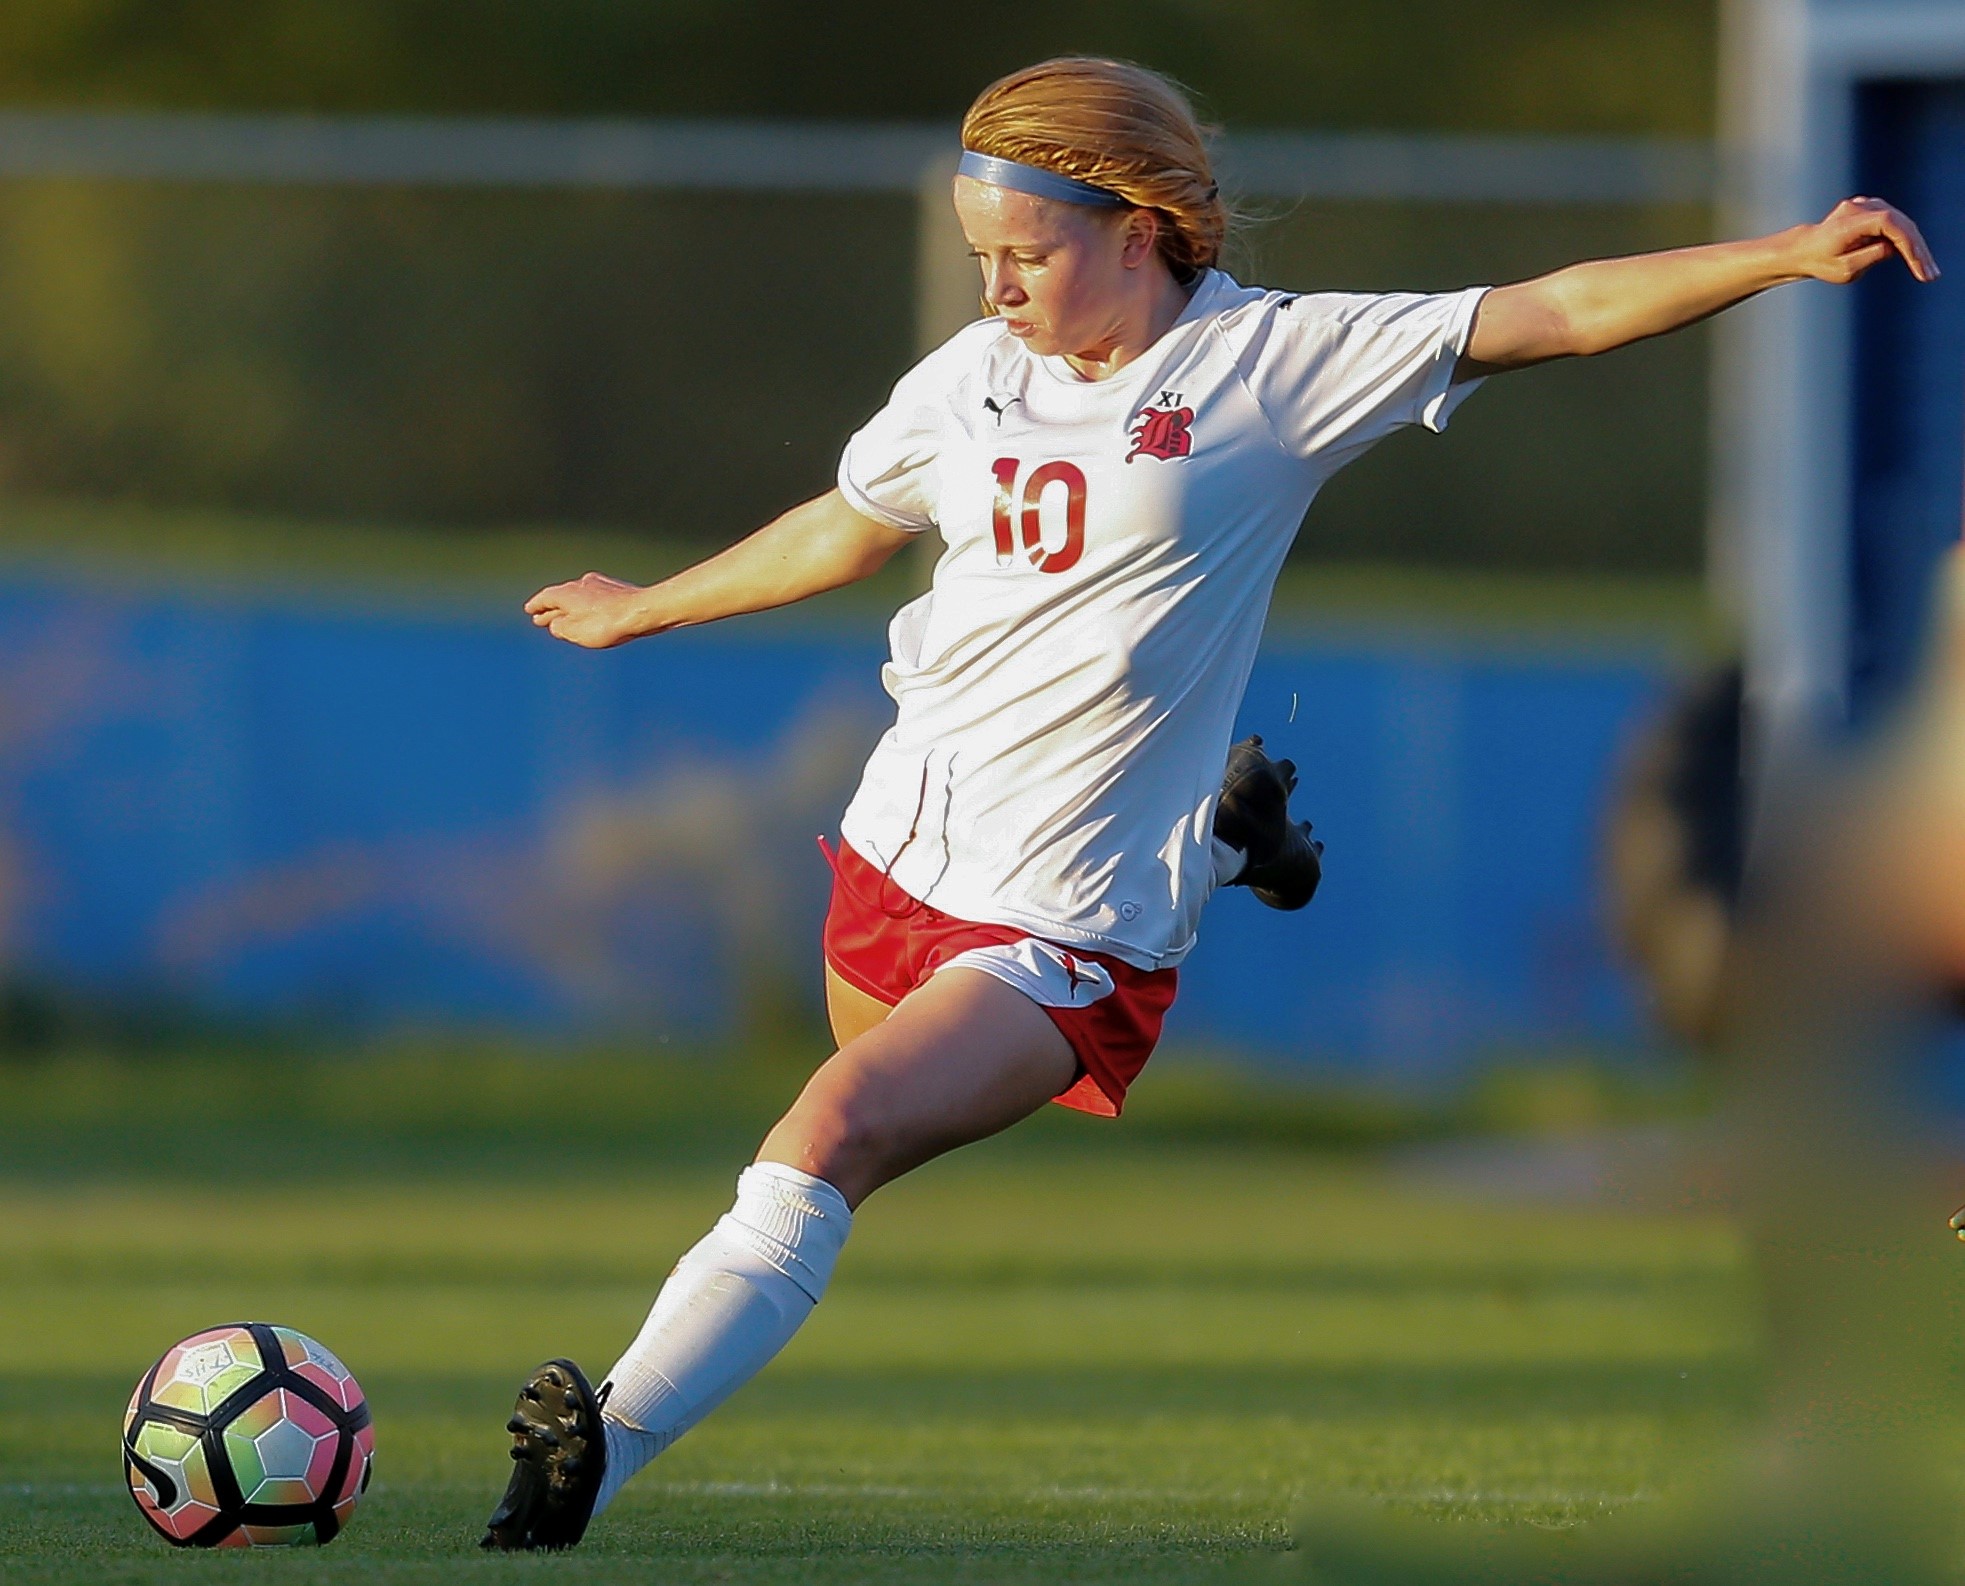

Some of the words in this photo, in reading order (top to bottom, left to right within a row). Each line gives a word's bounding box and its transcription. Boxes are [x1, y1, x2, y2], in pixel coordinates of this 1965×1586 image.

[1156, 391, 1184, 407] XI
[1125, 407, 1194, 464] B
[991, 457, 1087, 573] 10
